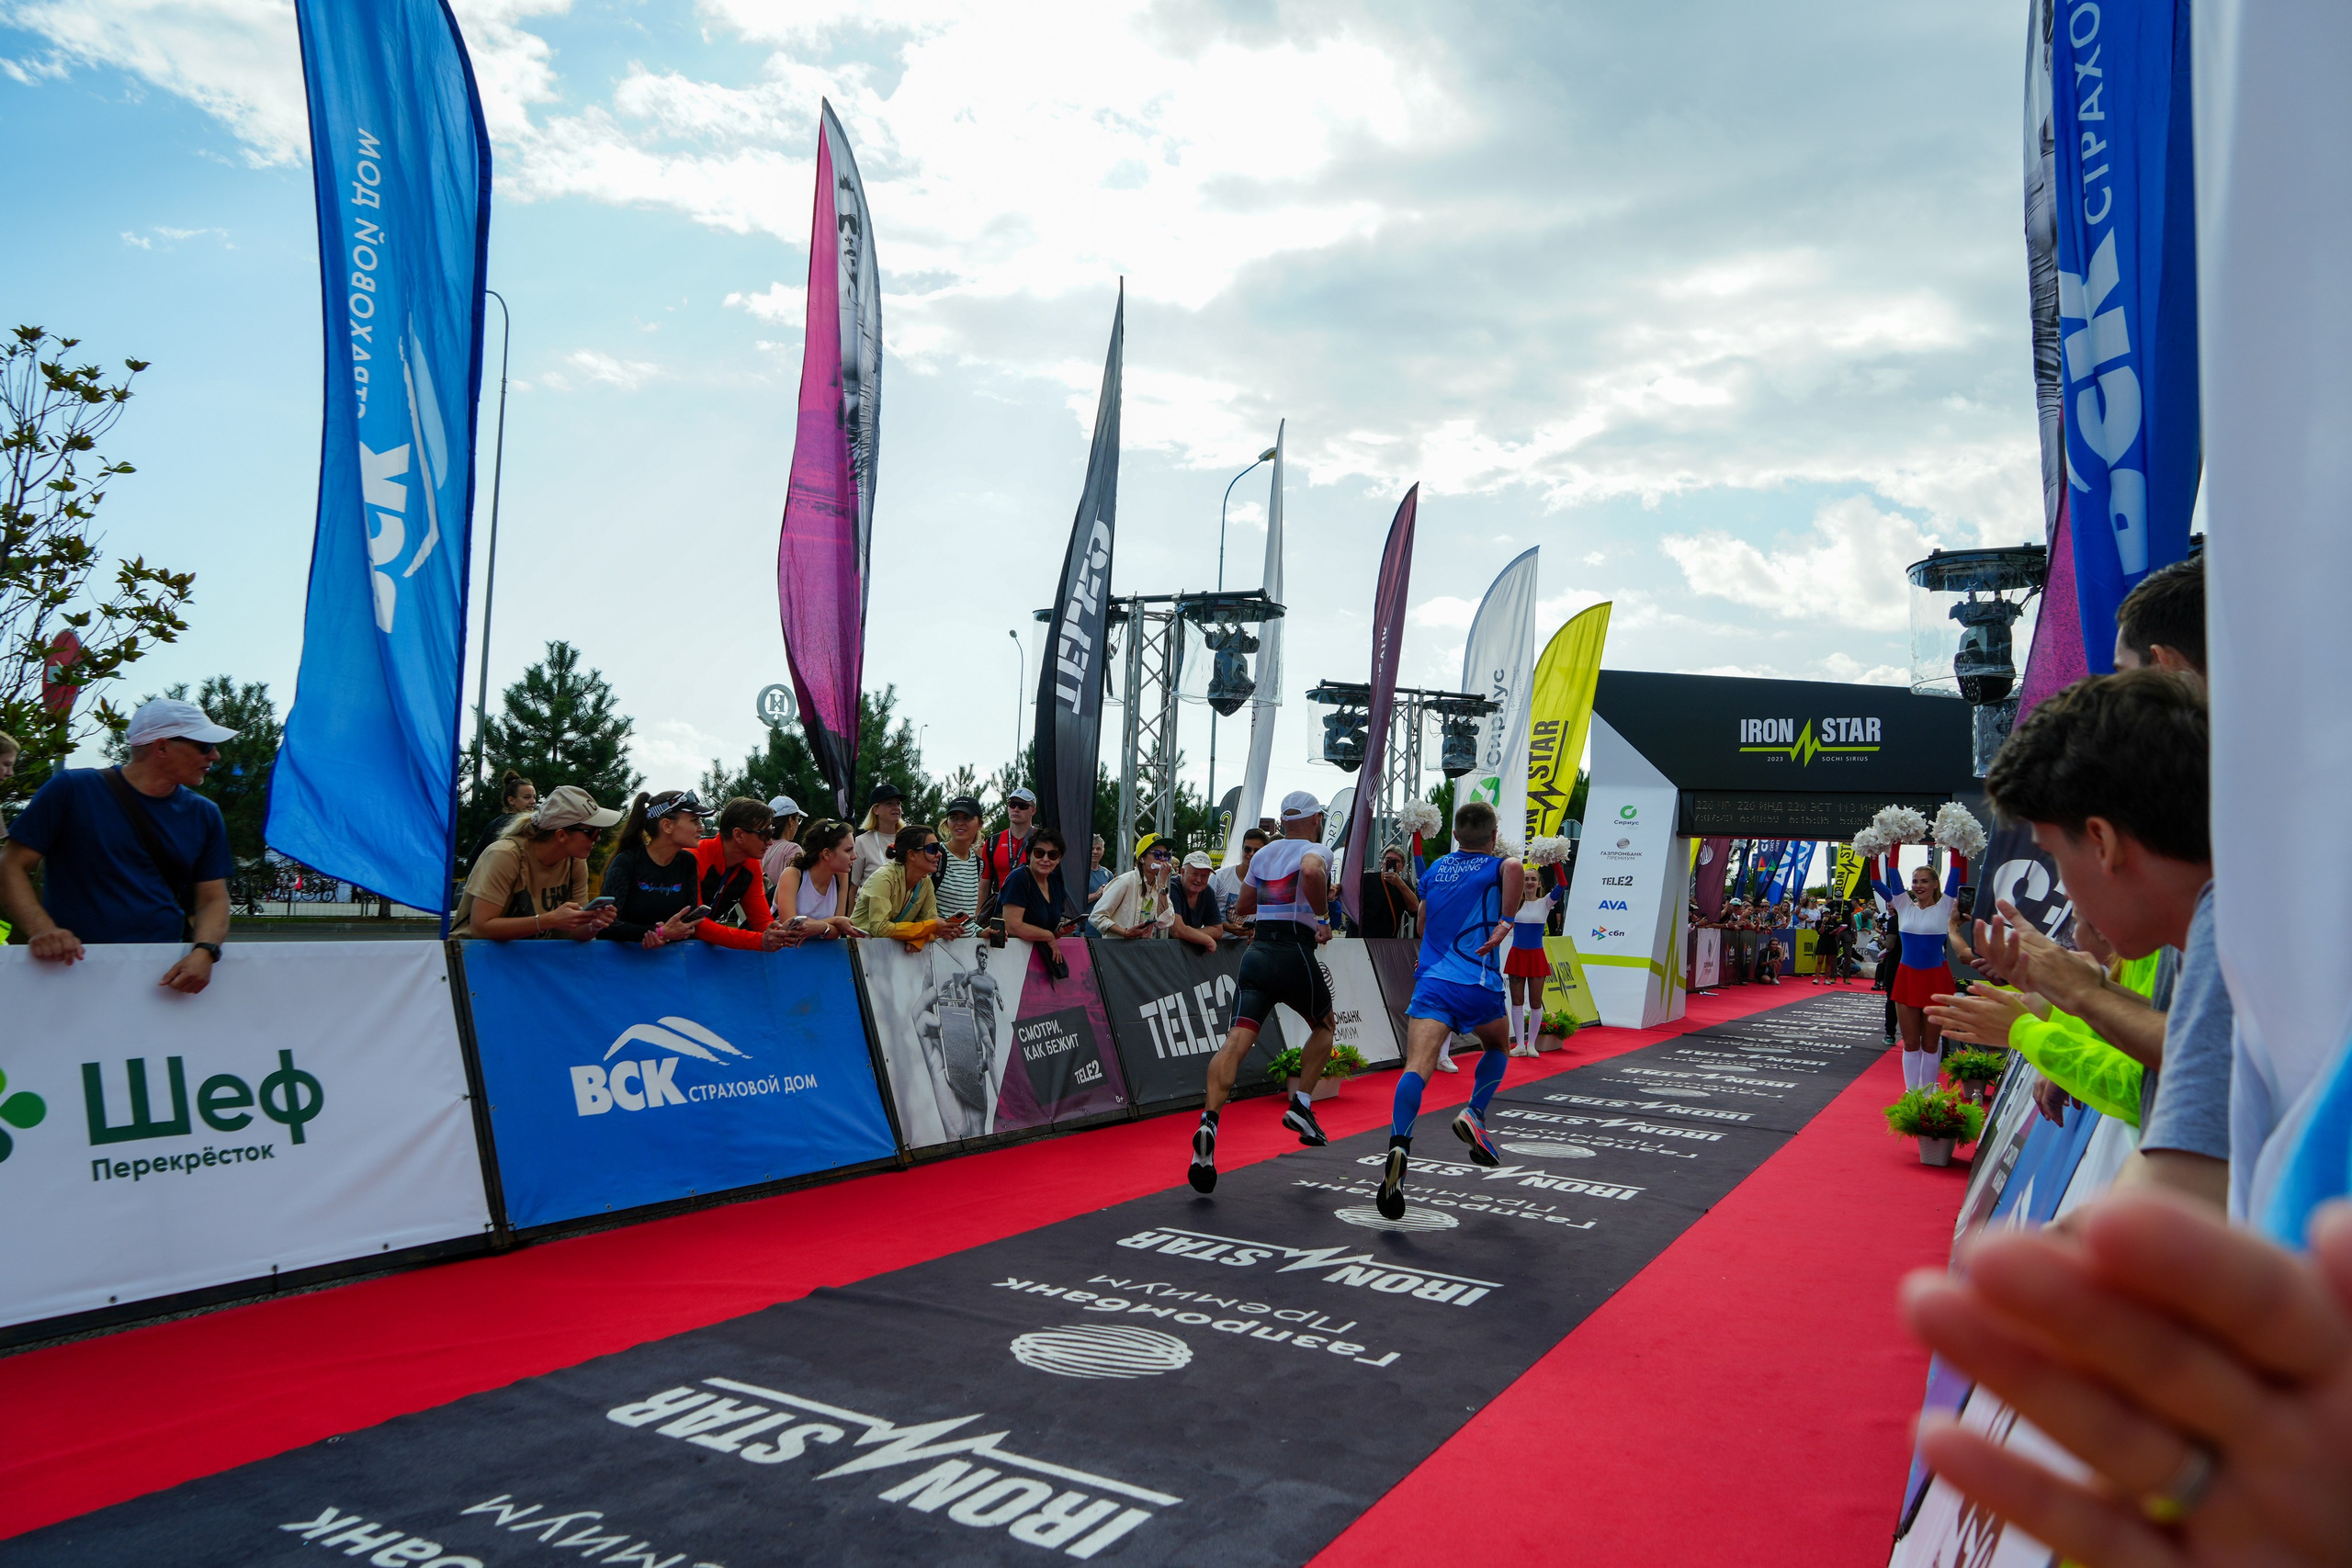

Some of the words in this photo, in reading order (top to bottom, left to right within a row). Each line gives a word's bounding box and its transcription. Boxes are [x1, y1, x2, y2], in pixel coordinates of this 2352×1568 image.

[1741, 718, 1793, 742] IRON
[1822, 717, 1881, 742] STAR
[1528, 720, 1560, 780] STAR
[1435, 874, 1459, 882] CLUB
[1437, 863, 1481, 873] RUNNING
[1602, 875, 1634, 886] TELE2
[1599, 900, 1627, 910] AVA
[1333, 1010, 1362, 1024] ОМБАНК
[1334, 1026, 1359, 1041] ЕМИУМ
[1023, 1044, 1046, 1061] КАК
[1046, 1033, 1080, 1055] БЕЖИТ
[1074, 1059, 1102, 1085] TELE2
[82, 1049, 324, 1146] Шеф
[570, 1057, 688, 1116] ВСК
[688, 1075, 780, 1102] СТРАХОВОЙ
[784, 1074, 818, 1094] ДОМ
[1544, 1094, 1629, 1108] STAR
[1496, 1110, 1591, 1125] STAR
[1665, 1107, 1752, 1122] IRON
[1627, 1125, 1724, 1142] IRON
[93, 1143, 276, 1182] Перекрёсток
[1356, 1154, 1474, 1177] STR
[1518, 1175, 1641, 1201] IRON
[1116, 1231, 1273, 1267] STAR
[1322, 1265, 1491, 1306] IRON
[1087, 1275, 1358, 1334] Премиум
[992, 1277, 1401, 1368] Газпромбанк
[607, 1387, 842, 1464] STAR
[878, 1459, 1154, 1560] IRON
